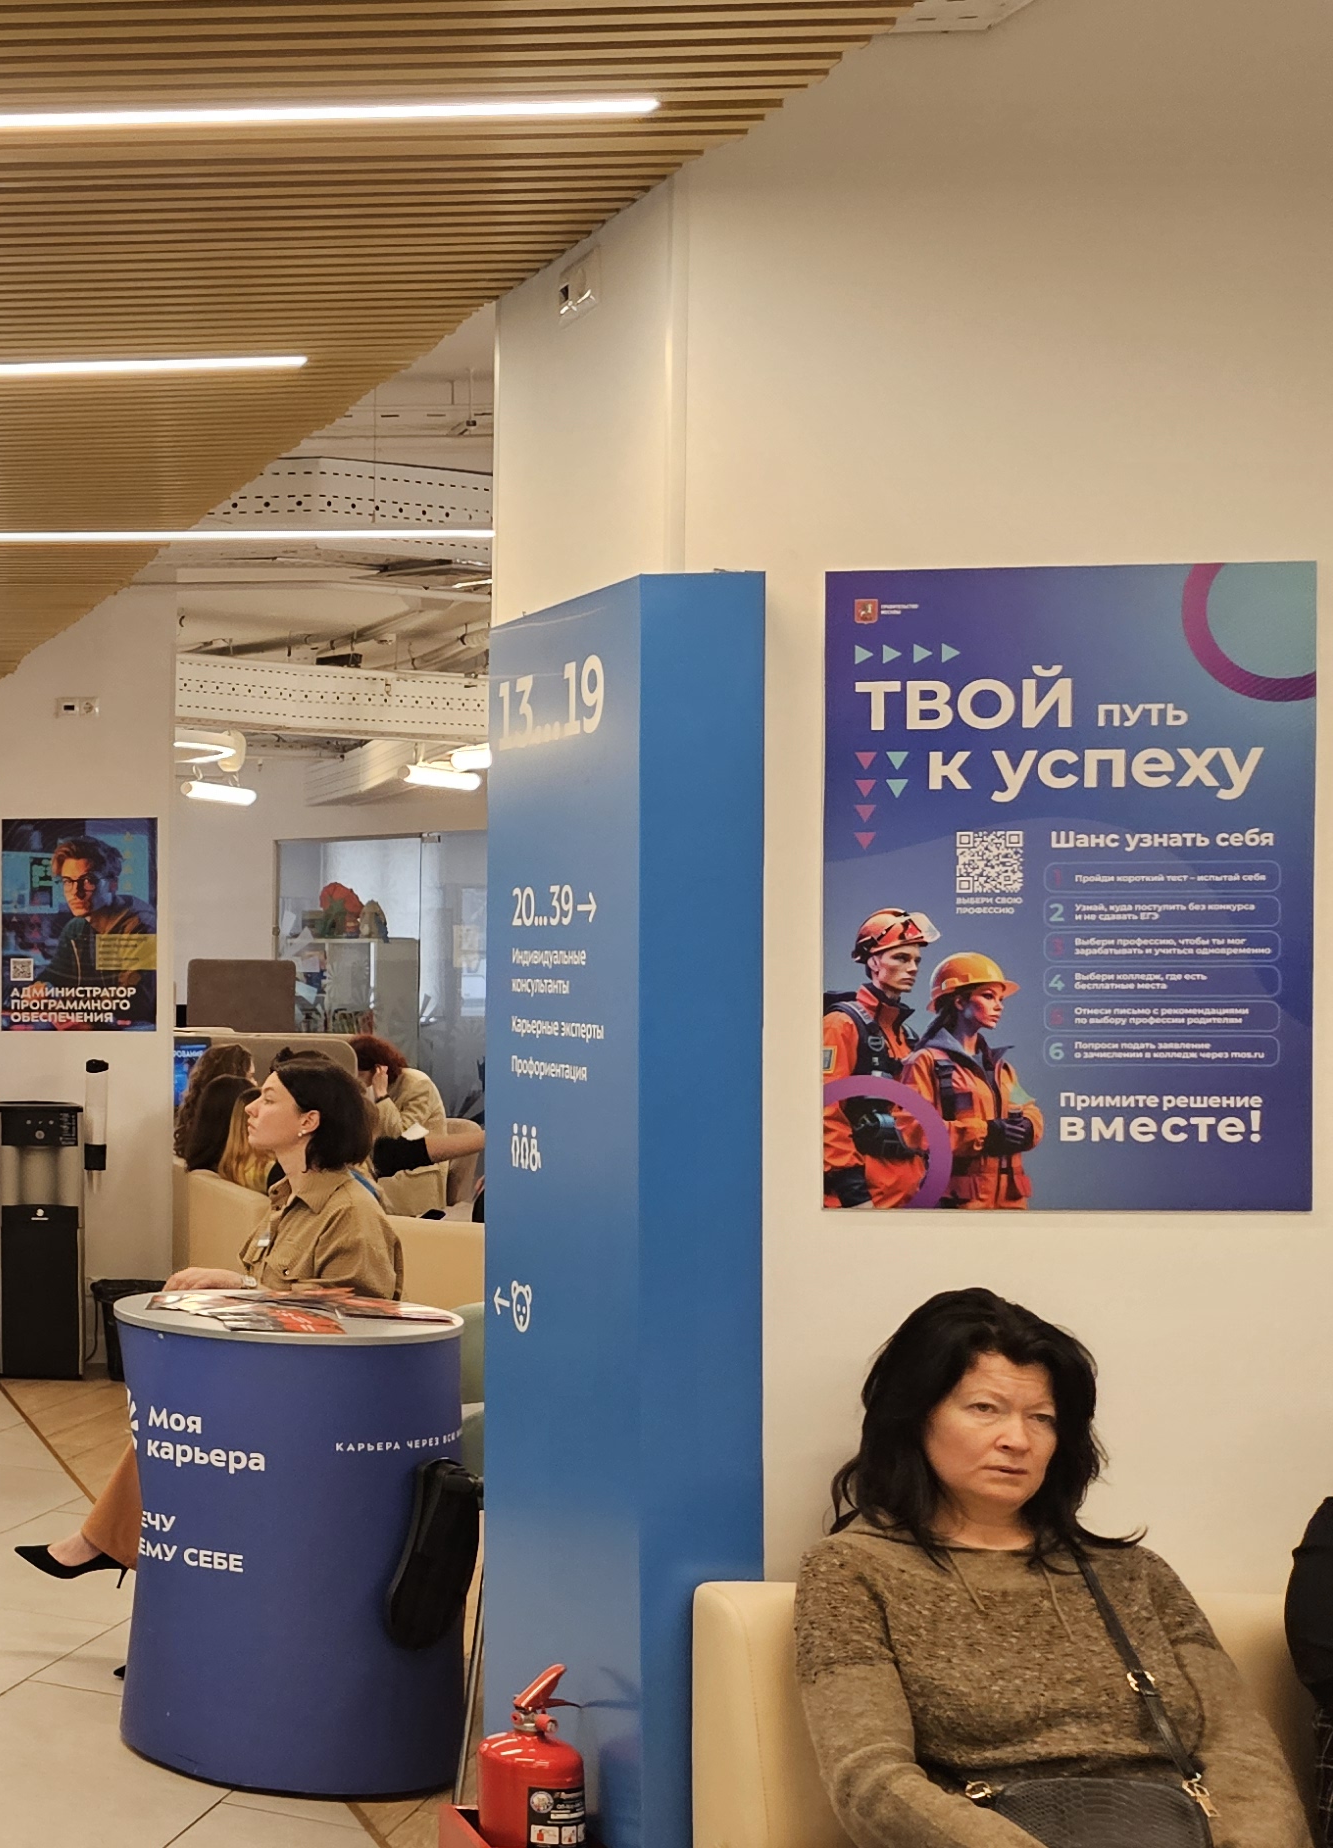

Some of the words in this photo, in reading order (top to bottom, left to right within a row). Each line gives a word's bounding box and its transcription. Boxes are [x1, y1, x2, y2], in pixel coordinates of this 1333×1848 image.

[855, 665, 1072, 730] ТВОЙ
[1097, 704, 1188, 727] ПУТЬ
[929, 751, 971, 790] к
[991, 747, 1264, 803] успеху
[1050, 831, 1118, 848] Шанс
[1125, 832, 1210, 852] узнать
[1216, 828, 1274, 847] себя
[1075, 874, 1115, 883] Пройди
[1116, 874, 1164, 884] короткий
[1197, 873, 1240, 882] испытай
[1242, 873, 1266, 881] себя
[512, 885, 573, 926] 20...39
[995, 896, 1023, 904] СВОЮ
[956, 906, 1015, 914] ПРОФЕССИЮ
[1049, 904, 1065, 922] 2
[1109, 904, 1132, 913] куда
[1135, 904, 1186, 912] поступить
[1188, 902, 1205, 911] без
[1208, 903, 1255, 912] конкурса
[1099, 913, 1138, 921] сдавать
[1140, 912, 1160, 920] ЕГЭ
[1074, 946, 1143, 956] зарабатывать
[1154, 947, 1194, 956] учиться
[1196, 946, 1272, 955] одновременно
[1075, 937, 1115, 946] Выбери
[1179, 937, 1209, 945] чтобы
[1227, 937, 1247, 945] мог
[512, 948, 586, 969] Индивидуальные
[512, 978, 569, 997] консультанты
[1049, 974, 1065, 991] 4
[1074, 972, 1114, 982] Выбери
[1165, 973, 1182, 981] где
[1184, 973, 1207, 981] есть
[1074, 981, 1135, 990] бесплатные
[10, 987, 136, 999] АДМИНИСТРАТОР
[11, 999, 130, 1010] ПРОГРАММНОГО
[1074, 1007, 1111, 1015] Отнеси
[1114, 1008, 1151, 1016] письмо
[1161, 1007, 1249, 1016] рекомендациями
[10, 1012, 114, 1023] ОБЕСПЕЧЕНИЯ
[1089, 1016, 1126, 1025] выбору
[1129, 1016, 1185, 1025] профессии
[1187, 1016, 1243, 1025] родителям
[511, 1016, 559, 1038] Карьерные
[561, 1021, 604, 1043] эксперты
[1049, 1042, 1065, 1060] 6
[1074, 1041, 1118, 1050] Попроси
[1120, 1042, 1156, 1050] подать
[1158, 1042, 1211, 1050] заявление
[1083, 1051, 1143, 1059] зачислении
[1153, 1051, 1197, 1060] колледж
[1199, 1051, 1229, 1060] через
[1231, 1051, 1265, 1059] mos.ru
[512, 1055, 587, 1082] Профориентация
[1060, 1092, 1159, 1110] Примите
[1162, 1094, 1263, 1111] решение
[1060, 1110, 1262, 1143] вместе!
[148, 1406, 202, 1434] Моя
[335, 1441, 401, 1451] КАРЬЕРА
[407, 1437, 439, 1448] ЧЕРЕЗ
[147, 1439, 265, 1474] карьера
[183, 1548, 244, 1572] СЕБЕ
